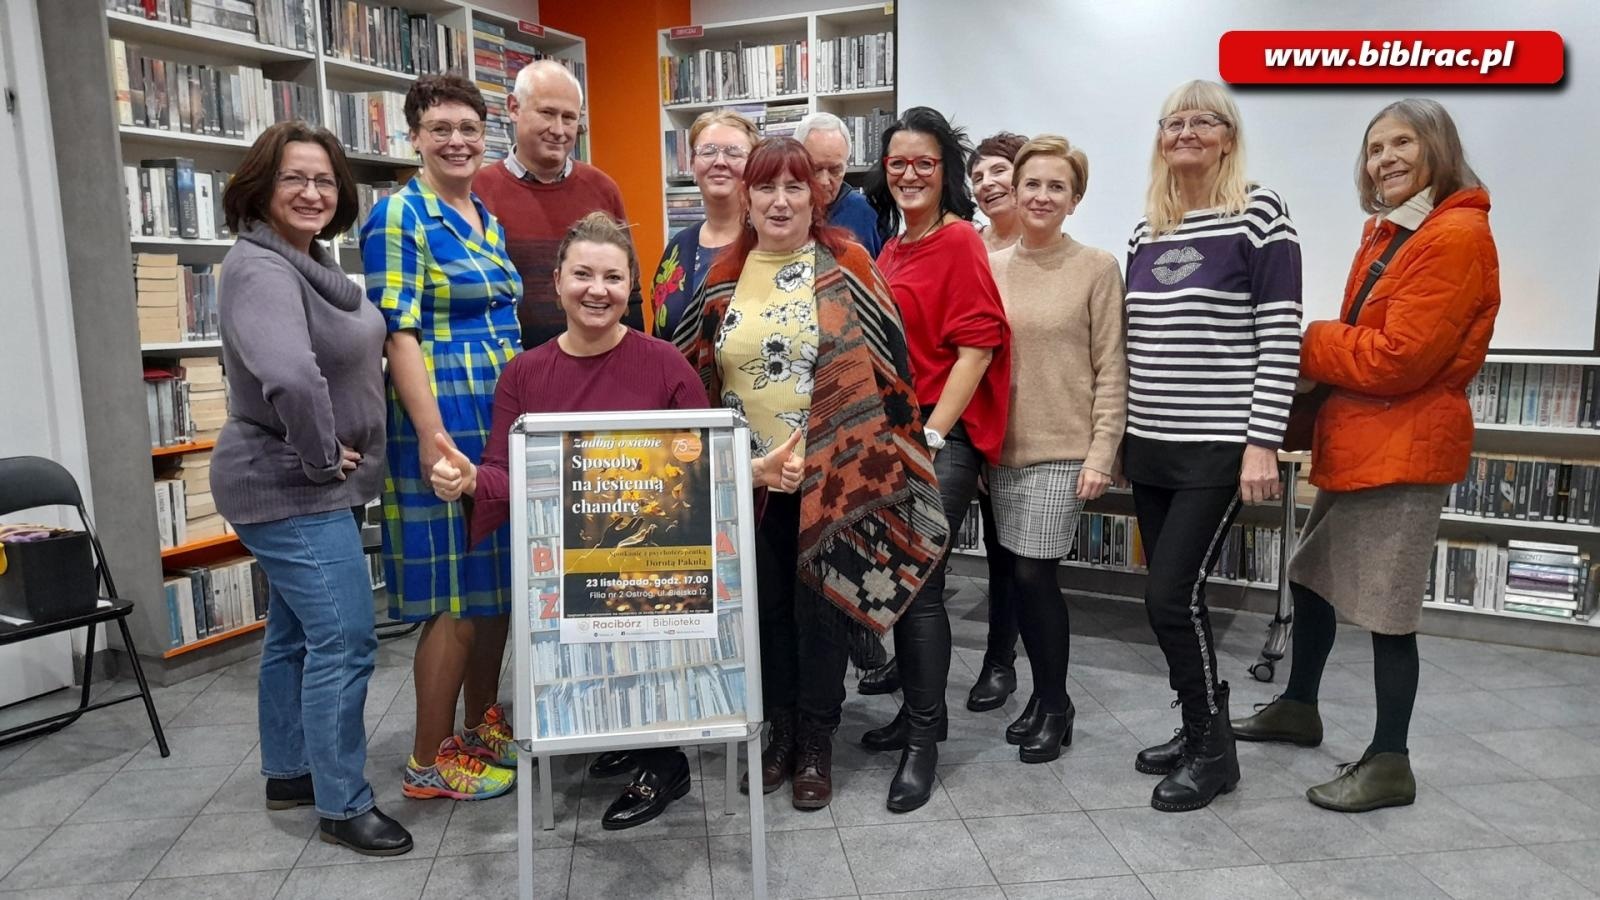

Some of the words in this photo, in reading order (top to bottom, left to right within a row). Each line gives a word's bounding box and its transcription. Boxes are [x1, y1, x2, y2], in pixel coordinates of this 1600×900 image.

[573, 437, 615, 450] Zadbaj
[618, 439, 625, 448] o
[627, 437, 662, 449] siebie
[673, 438, 688, 453] 75
[572, 454, 640, 472] Sposoby
[572, 479, 592, 491] na
[594, 477, 664, 494] jesienną
[572, 499, 640, 516] chandrę
[586, 578, 598, 588] 23
[654, 576, 682, 588] godz.
[684, 575, 709, 585] 17.00
[590, 591, 606, 599] Filia
[619, 590, 624, 598] 2
[592, 619, 642, 630] Racibórz
[653, 616, 701, 628] Biblioteka
